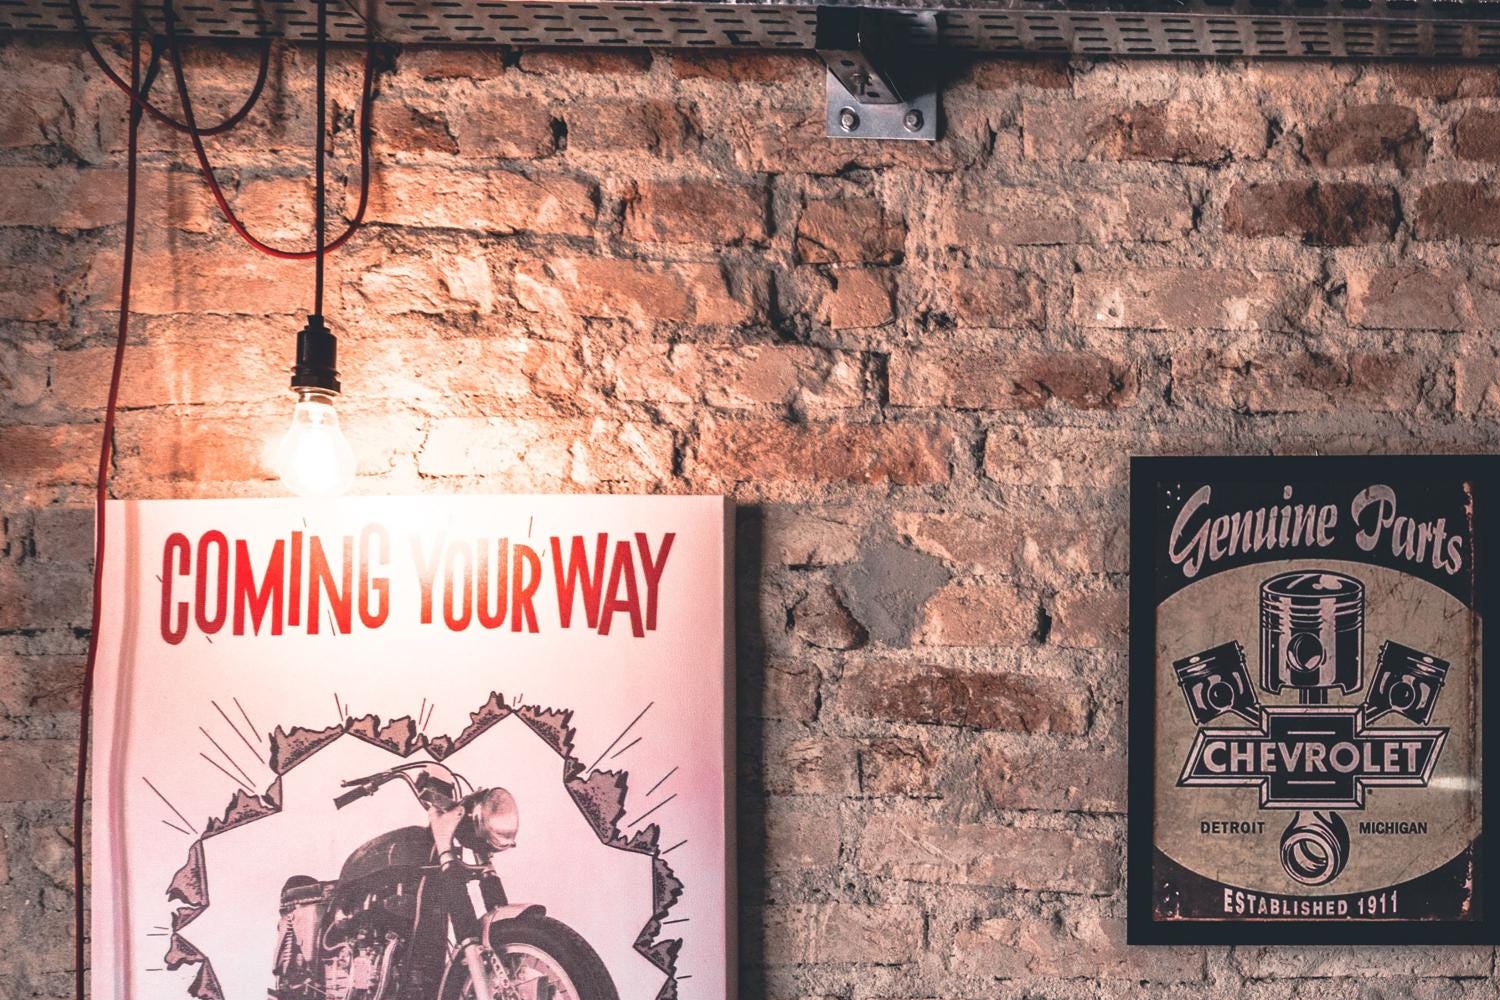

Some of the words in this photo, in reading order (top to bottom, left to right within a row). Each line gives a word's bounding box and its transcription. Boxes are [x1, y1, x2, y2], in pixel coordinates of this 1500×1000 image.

[1168, 484, 1338, 578] Genuine
[1351, 484, 1463, 576] Parts
[161, 522, 391, 645] COMING
[410, 536, 542, 633] YOUR
[550, 531, 676, 638] WAY
[1203, 741, 1422, 773] CHEVROLET
[1200, 821, 1266, 835] DETROIT
[1359, 821, 1428, 835] MICHIGAN
[1223, 887, 1348, 916] ESTABLISHED
[1357, 890, 1398, 915] 1911
